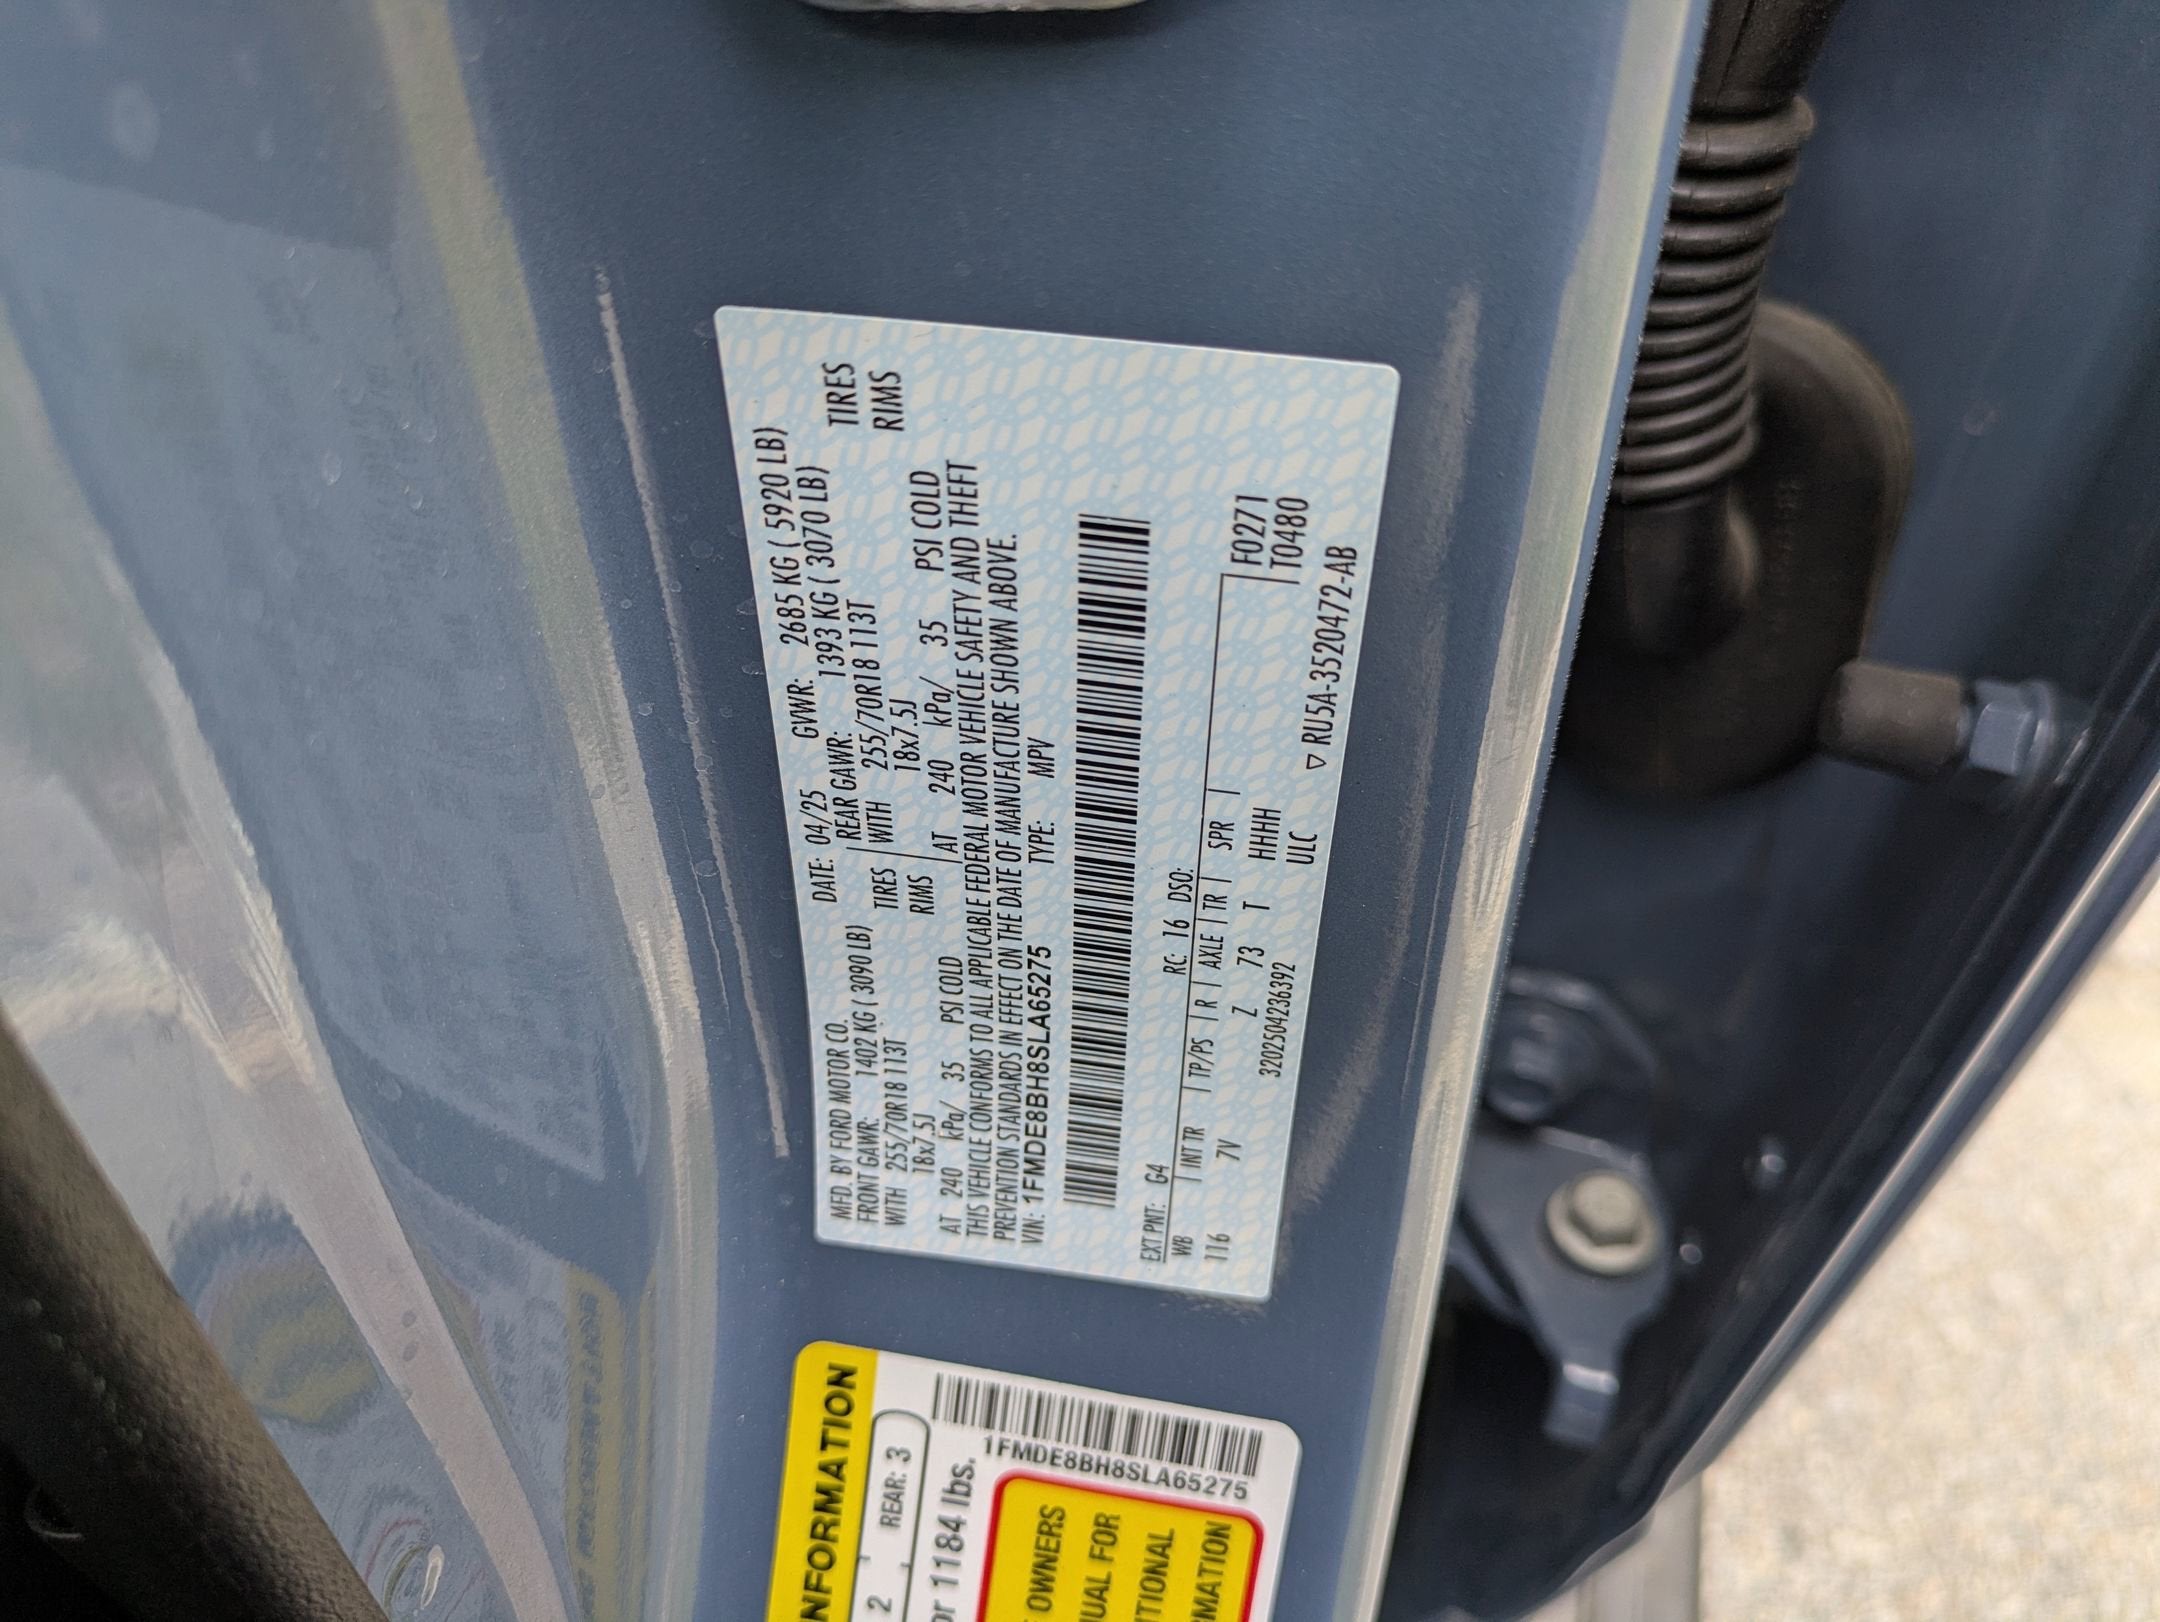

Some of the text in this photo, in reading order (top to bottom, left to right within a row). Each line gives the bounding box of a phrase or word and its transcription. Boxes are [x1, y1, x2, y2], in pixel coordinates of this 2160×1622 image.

[821, 362, 860, 427] TIRES
[867, 370, 905, 432] RIMS
[752, 426, 789, 465] LB)
[758, 472, 796, 532] 5920
[794, 465, 830, 503] LB)
[799, 510, 835, 569] 3070
[1230, 494, 1269, 566] F0271
[1269, 496, 1310, 569] T0480
[769, 556, 802, 586] KG
[774, 592, 809, 647] 2685
[808, 591, 841, 621] KG
[813, 627, 846, 677] 1393
[908, 470, 959, 855] AT 240 kPa/ 35 PSI COLD
[1300, 545, 1358, 746] RU5A-3520472-AB
[786, 678, 820, 739] GVWR:
[845, 598, 894, 844] WITH 255/70R18 113T
[888, 698, 921, 772] 18x7.5J
[825, 731, 862, 841] REAR GAWR:
[1027, 736, 1055, 864] TYPE: MPV
[799, 789, 838, 903] DATE: 04/25
[945, 459, 994, 1237] THIS VEHICLE CONFORMS TO ALL APPLICABLE FEDERAL MOTOR VEHICLE SAFETY AND THEFT
[1207, 820, 1235, 851] SPR
[1247, 807, 1282, 861] HHHH
[1285, 831, 1318, 865] ULC
[869, 867, 899, 910] TIRES
[906, 874, 935, 916] RIMS
[986, 534, 1024, 1242] PREVENTION STANDARDS IN EFFECT ON THE DATE OF MANUFACTURE SHOWN ABOVE.
[1201, 893, 1228, 911] TR
[1242, 900, 1270, 911] T
[844, 924, 873, 951] LB)
[1162, 867, 1194, 976] RC: 16 DSO:
[847, 954, 875, 996] 3090
[1197, 933, 1224, 971] AXLE
[1236, 945, 1265, 968] 73
[851, 1010, 877, 1034] KG
[1194, 998, 1218, 1009] R
[1231, 1005, 1258, 1018] Z
[1258, 961, 1296, 1078] 3202504236392
[852, 1037, 879, 1077] 1402
[1187, 1037, 1215, 1078] TP/PS
[823, 1019, 853, 1221] MFD. BY FORD MOTOR CO.
[937, 955, 968, 1236] AT 240 kPa/ 35 PSI COLD
[1021, 944, 1052, 1245] VIN: 1FMDE8BH8SLA65275
[882, 1036, 912, 1227] WITH 255/70R18 113T
[911, 1112, 936, 1174] 18x7.5J
[1179, 1126, 1205, 1169] INT TR
[1215, 1138, 1242, 1162] 7V
[856, 1117, 880, 1224] FRONT GAWR:
[1139, 1163, 1170, 1263] EXT PNT: G4
[1171, 1235, 1194, 1257] WB
[1203, 1233, 1231, 1262] 116
[880, 1446, 911, 1528] REAR: 3
[940, 1458, 975, 1507] lbs.
[983, 1435, 1248, 1500] 1FMDE8BH8SLA65275
[929, 1514, 967, 1586] 1184
[1026, 1504, 1066, 1612] OWNERS
[1089, 1512, 1120, 1562] FOR
[867, 1594, 891, 1613] 2
